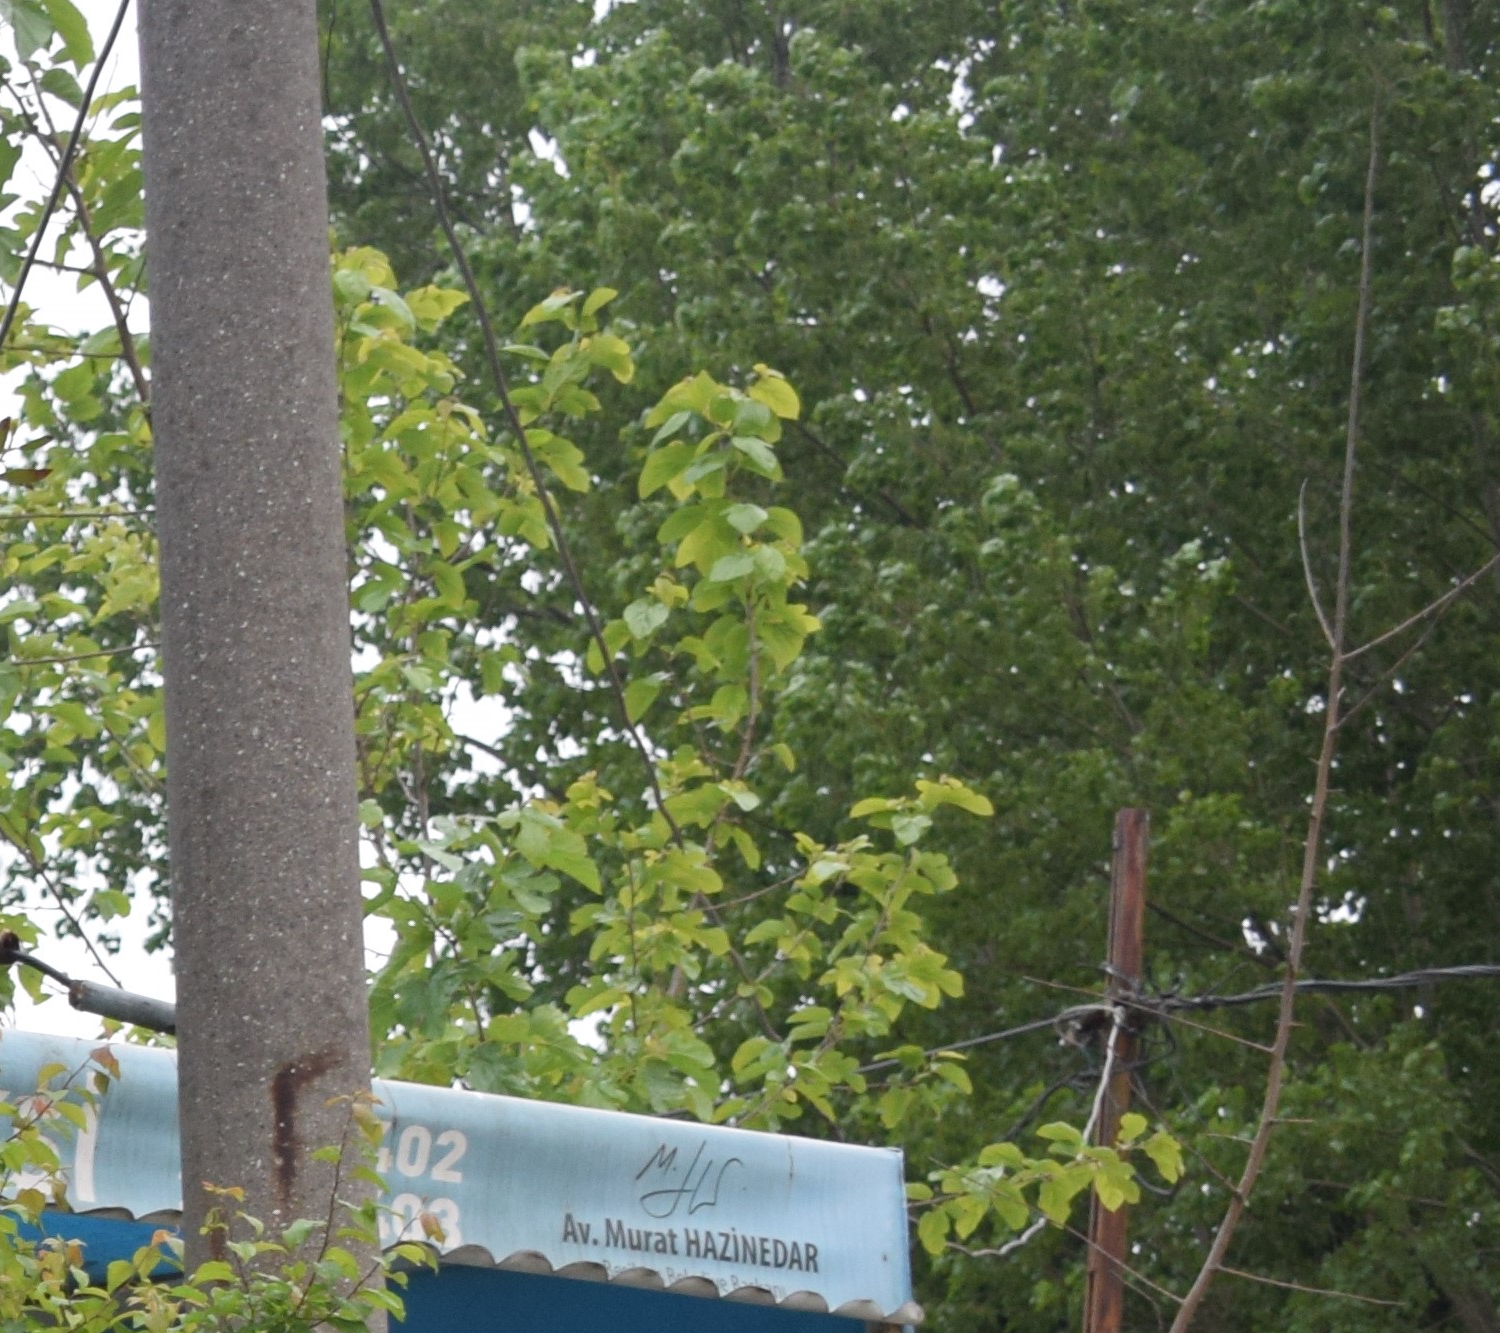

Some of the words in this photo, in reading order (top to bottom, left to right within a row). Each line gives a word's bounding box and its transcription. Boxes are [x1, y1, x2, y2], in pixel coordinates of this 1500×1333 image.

[563, 1213, 598, 1246] Av.
[605, 1218, 678, 1255] Murat
[685, 1227, 819, 1273] HAZİNEDAR
